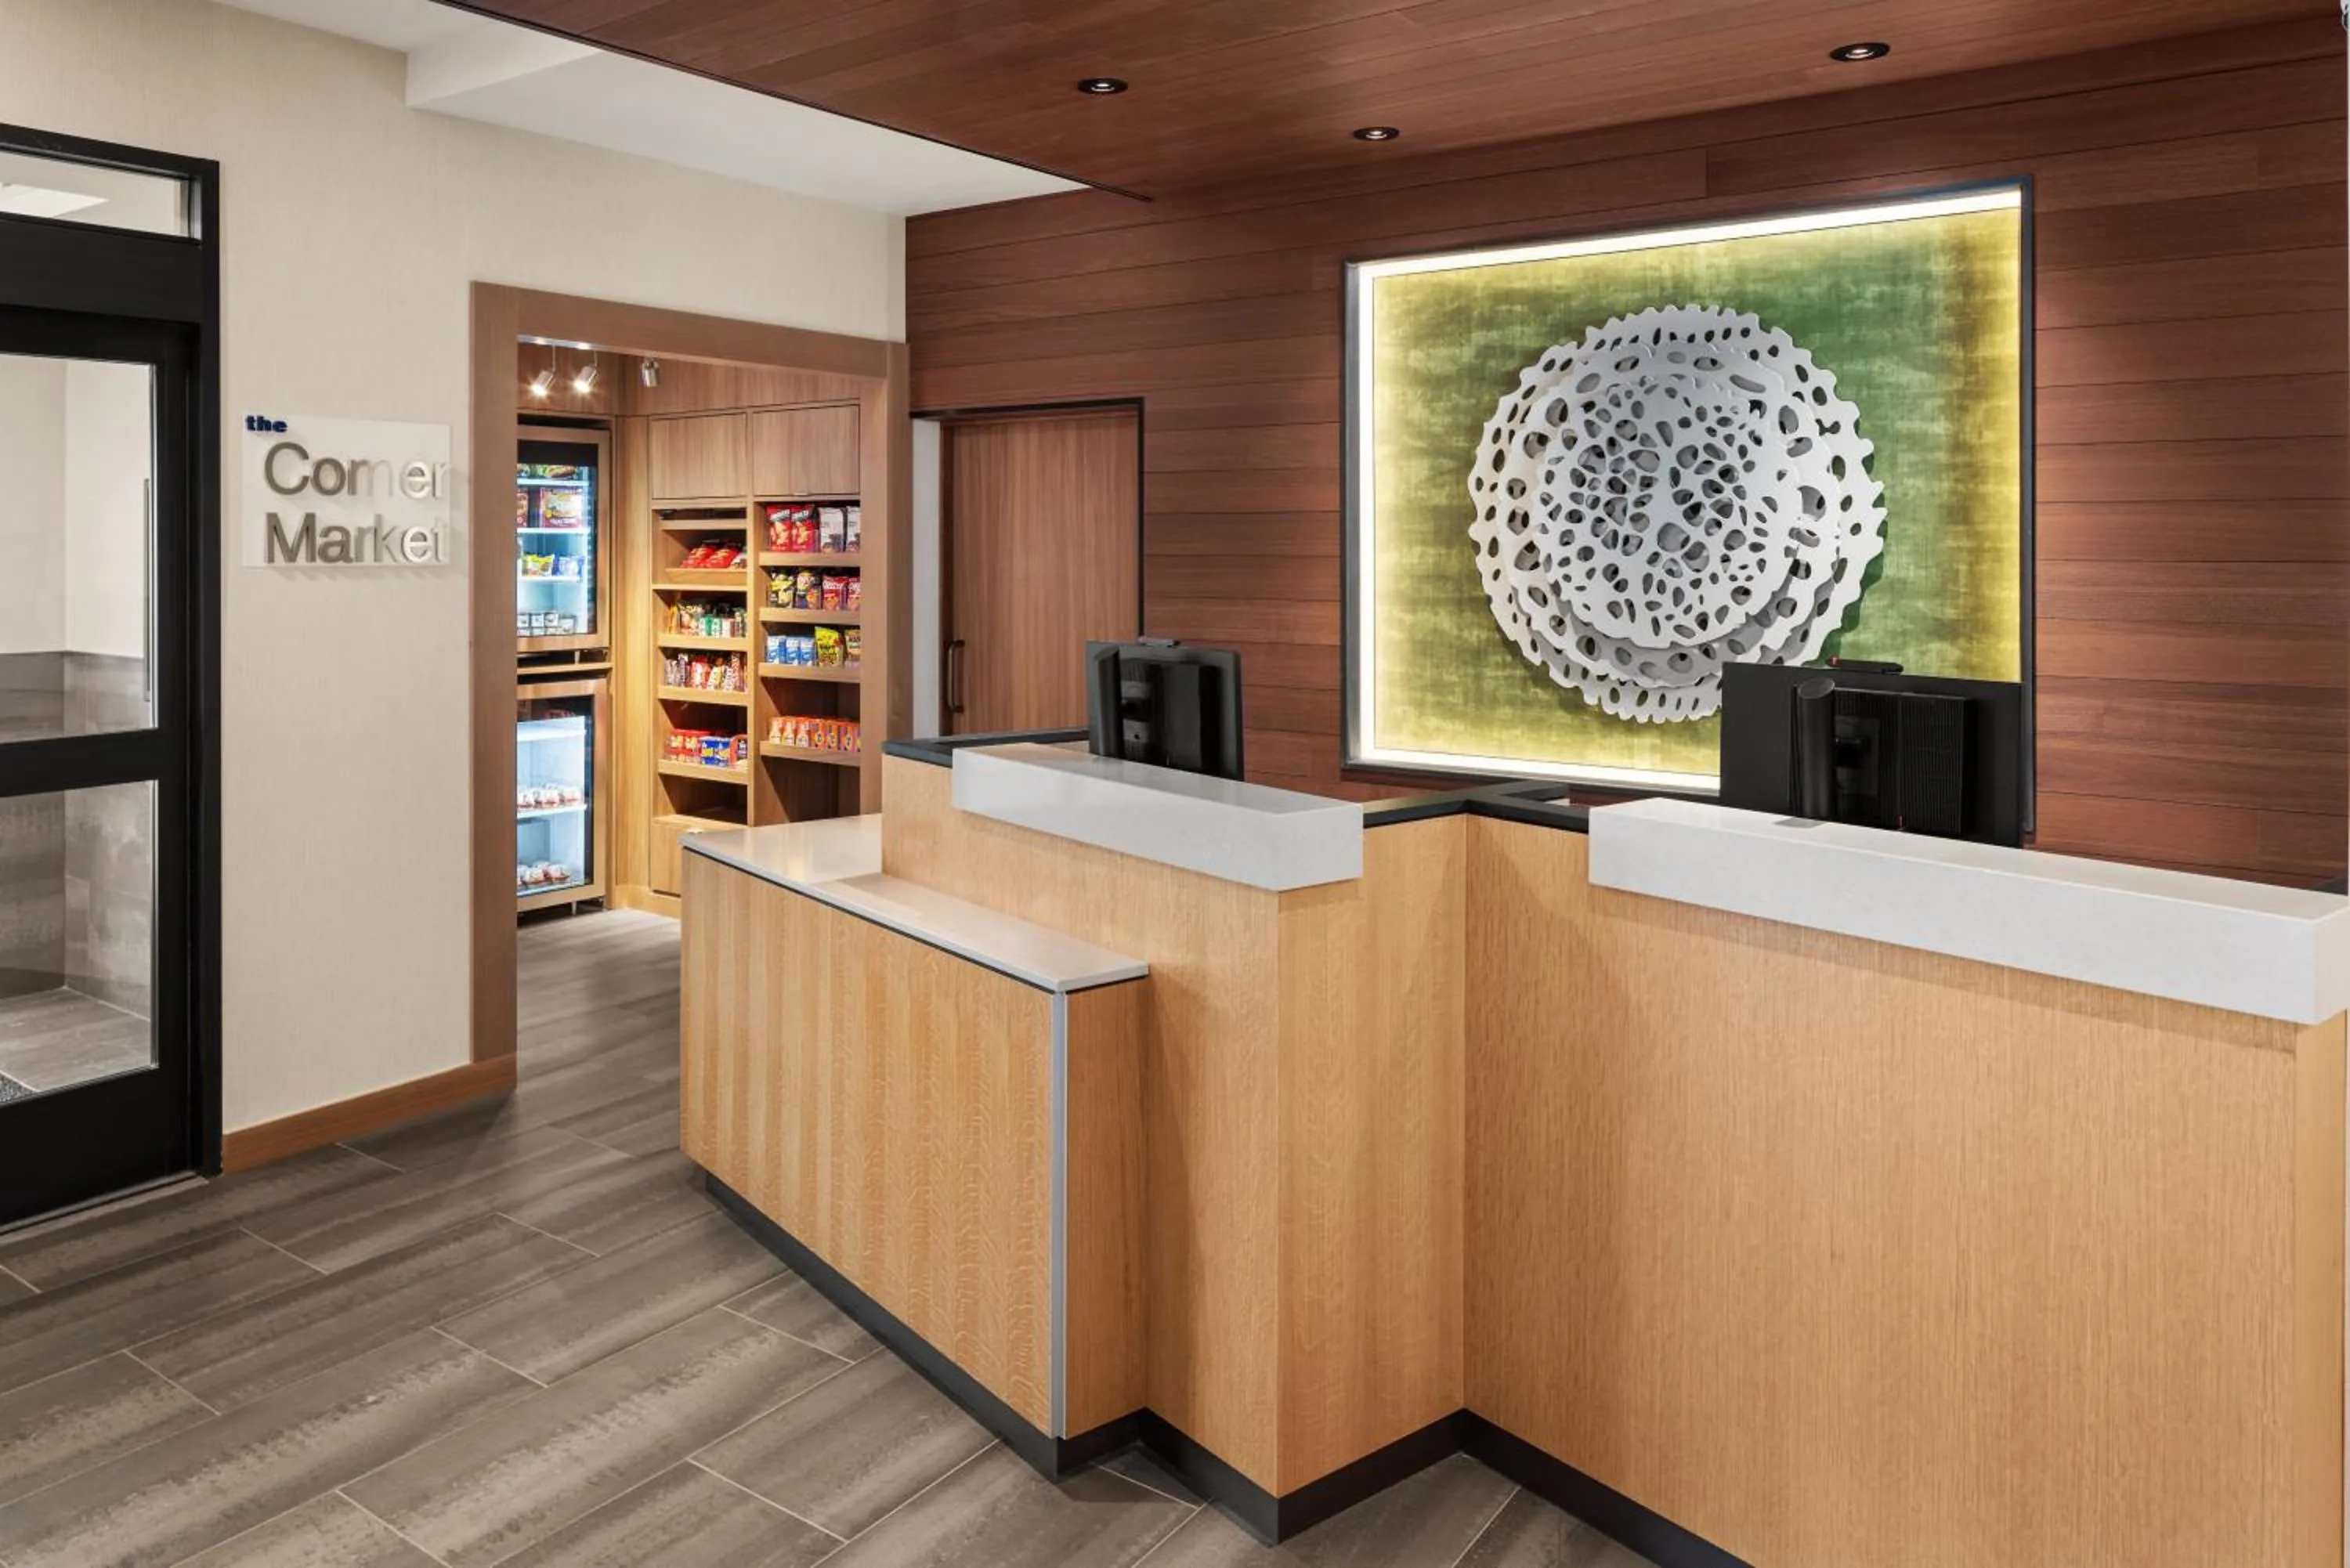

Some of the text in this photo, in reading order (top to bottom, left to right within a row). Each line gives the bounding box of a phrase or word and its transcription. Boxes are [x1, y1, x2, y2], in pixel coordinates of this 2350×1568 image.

[245, 415, 287, 432] the
[264, 441, 454, 499] Corner
[264, 511, 449, 565] Market
